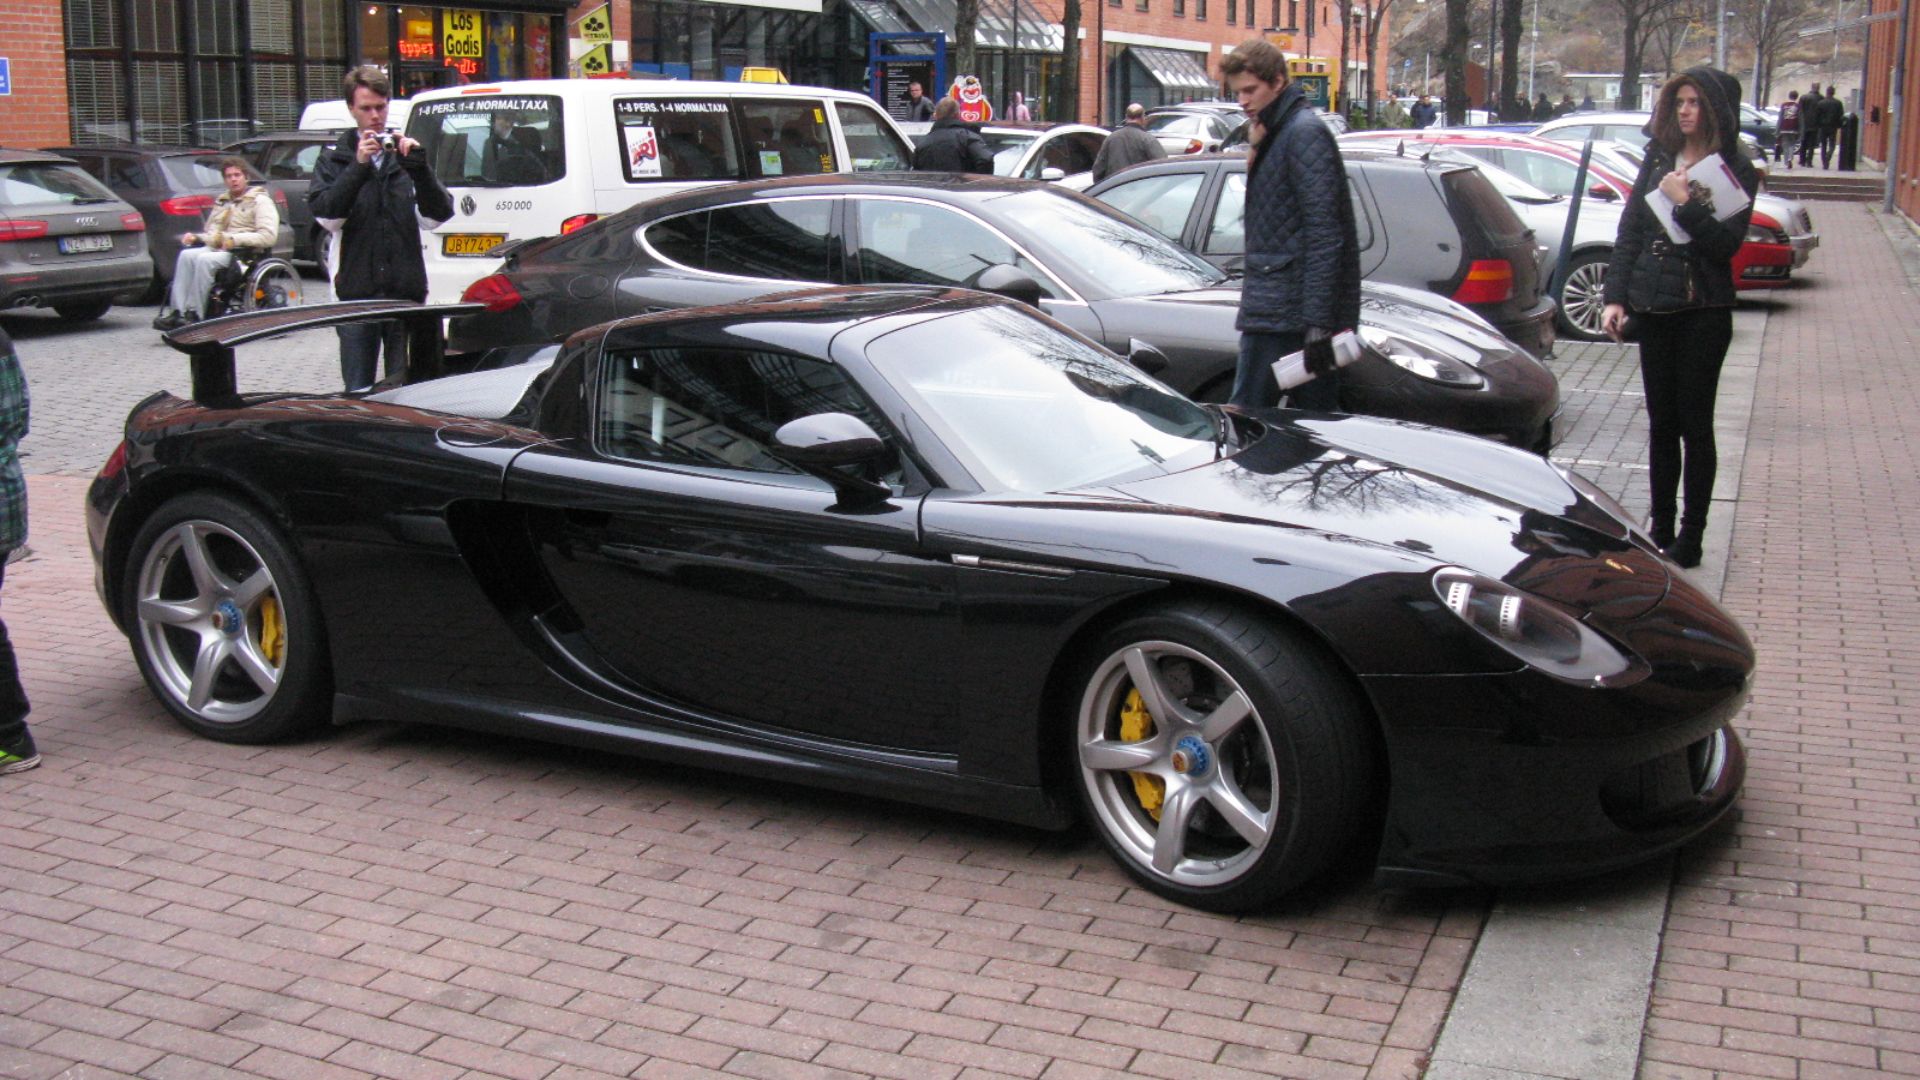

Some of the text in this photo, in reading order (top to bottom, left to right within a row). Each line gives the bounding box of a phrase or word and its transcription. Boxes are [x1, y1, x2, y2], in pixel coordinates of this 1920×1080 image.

[445, 34, 480, 55] Godis
[418, 100, 549, 115] 1-8 PERS. 1-4 NORMALTAXA
[618, 103, 729, 113] 1-8 PERS. 1-4 NORMALTAXA
[495, 200, 532, 211] 650 000
[448, 238, 492, 252] JBY743
